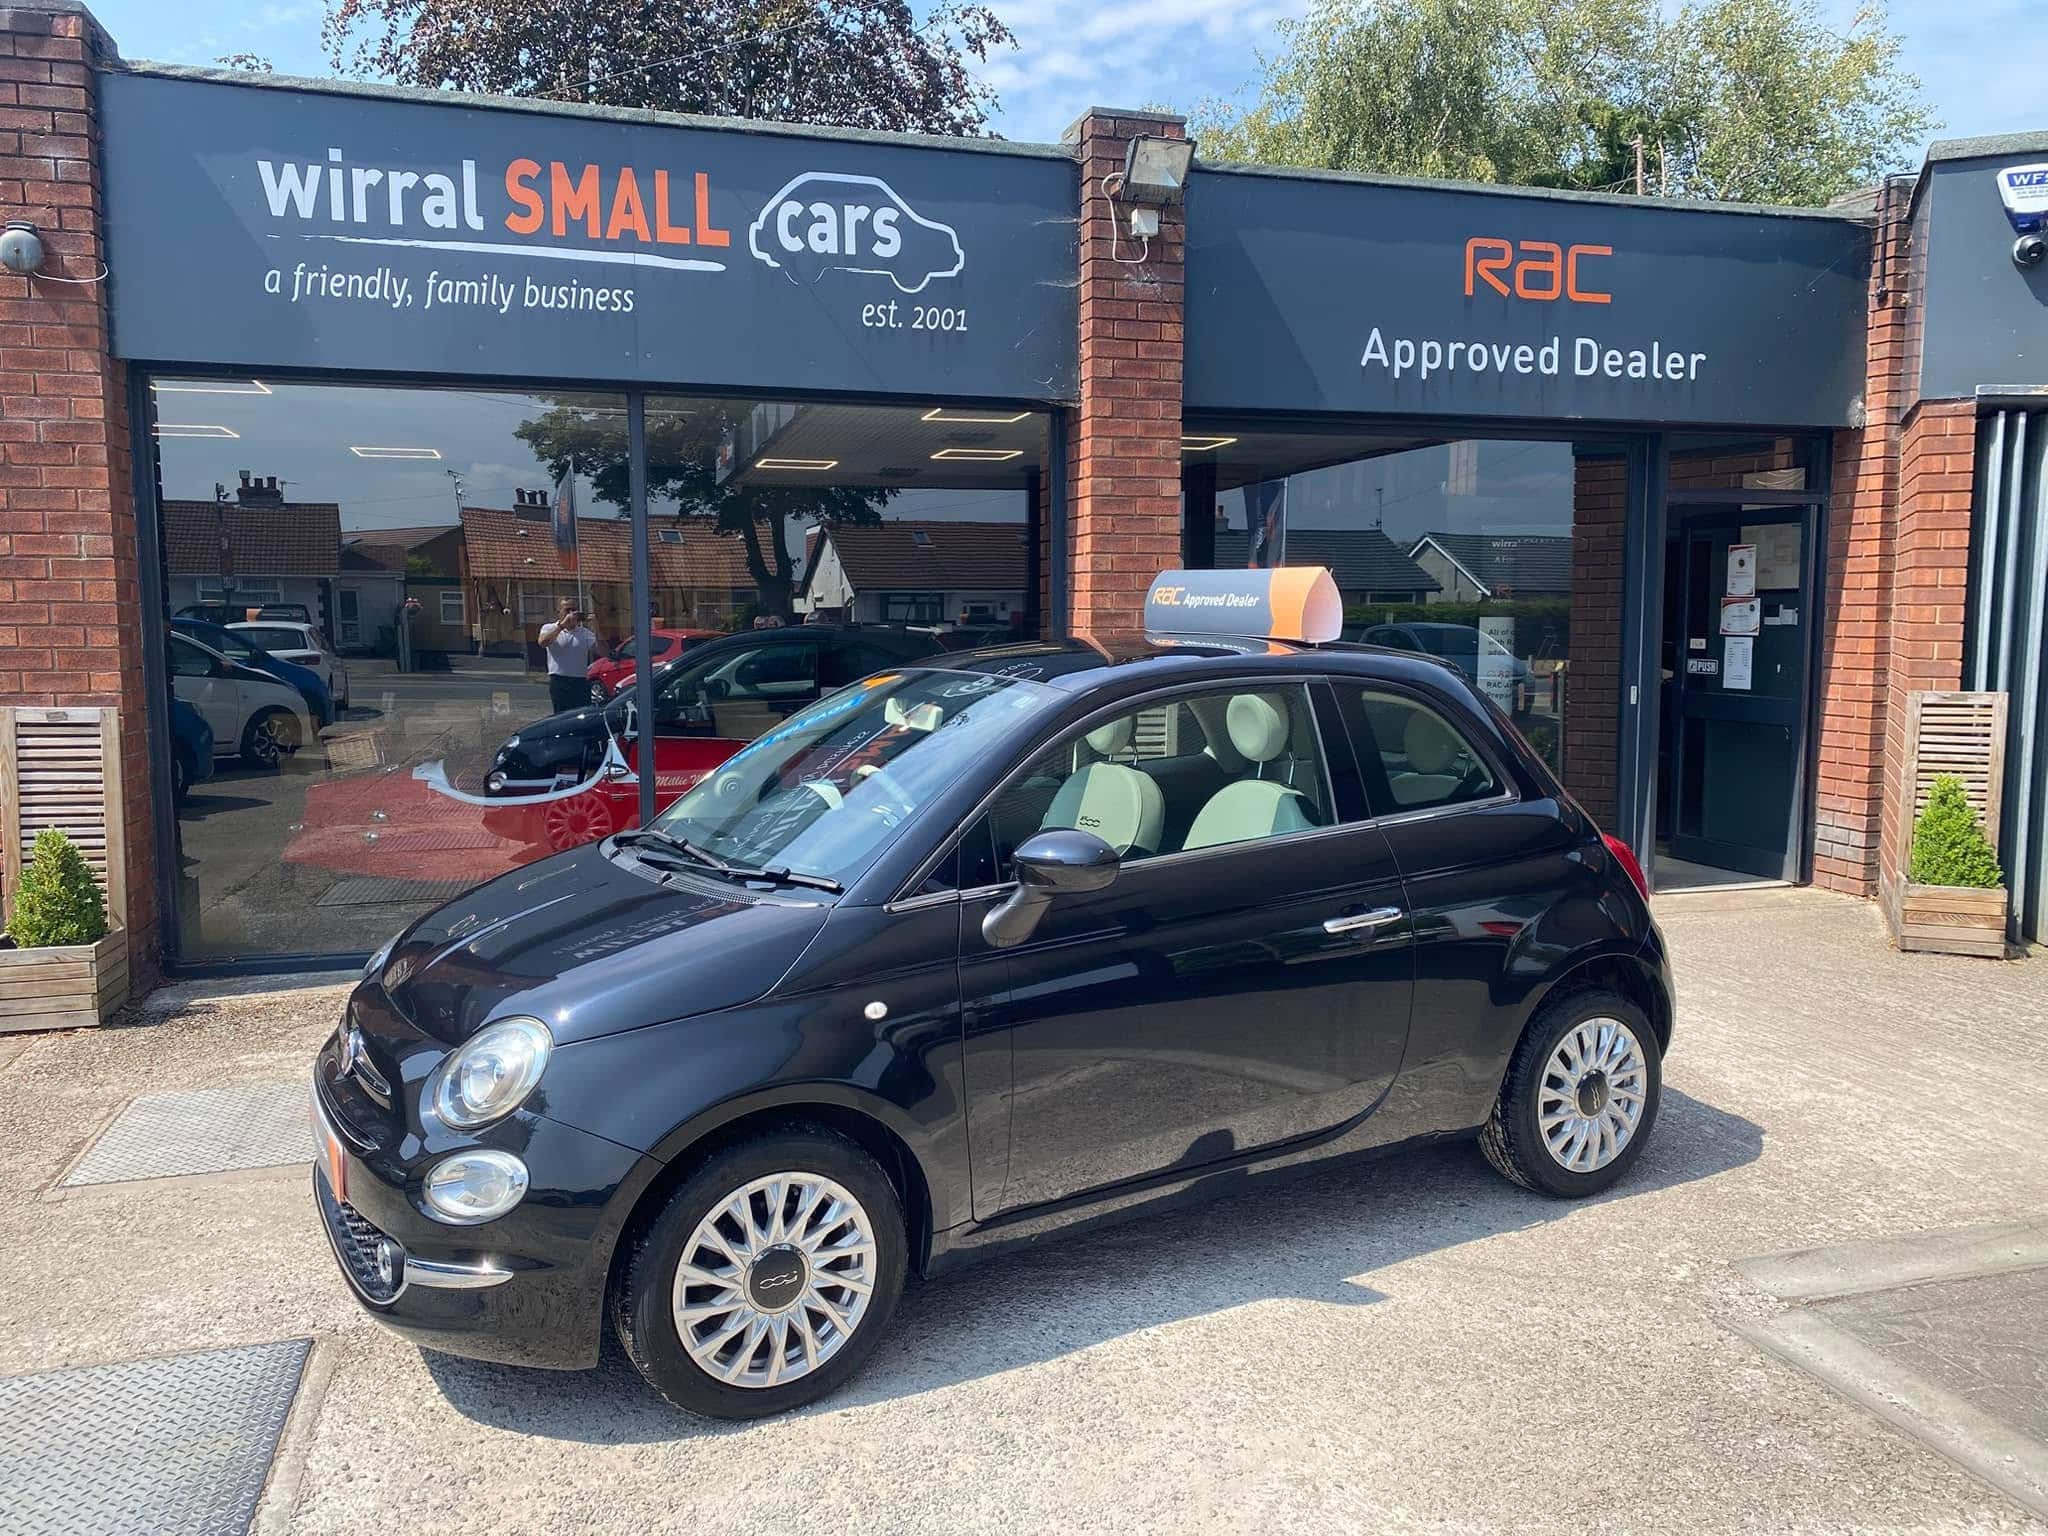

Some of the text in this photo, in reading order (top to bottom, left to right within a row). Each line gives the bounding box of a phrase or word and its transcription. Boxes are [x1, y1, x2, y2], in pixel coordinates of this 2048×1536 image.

[256, 148, 731, 247] wirral SMALL
[776, 200, 902, 258] cars
[264, 263, 635, 313] a friendly, family business
[861, 300, 968, 331] est. 2001
[1360, 327, 1707, 381] Approved Dealer
[1183, 593, 1225, 608] Approved
[1226, 593, 1260, 607] Dealer
[1079, 815, 1101, 828] 500
